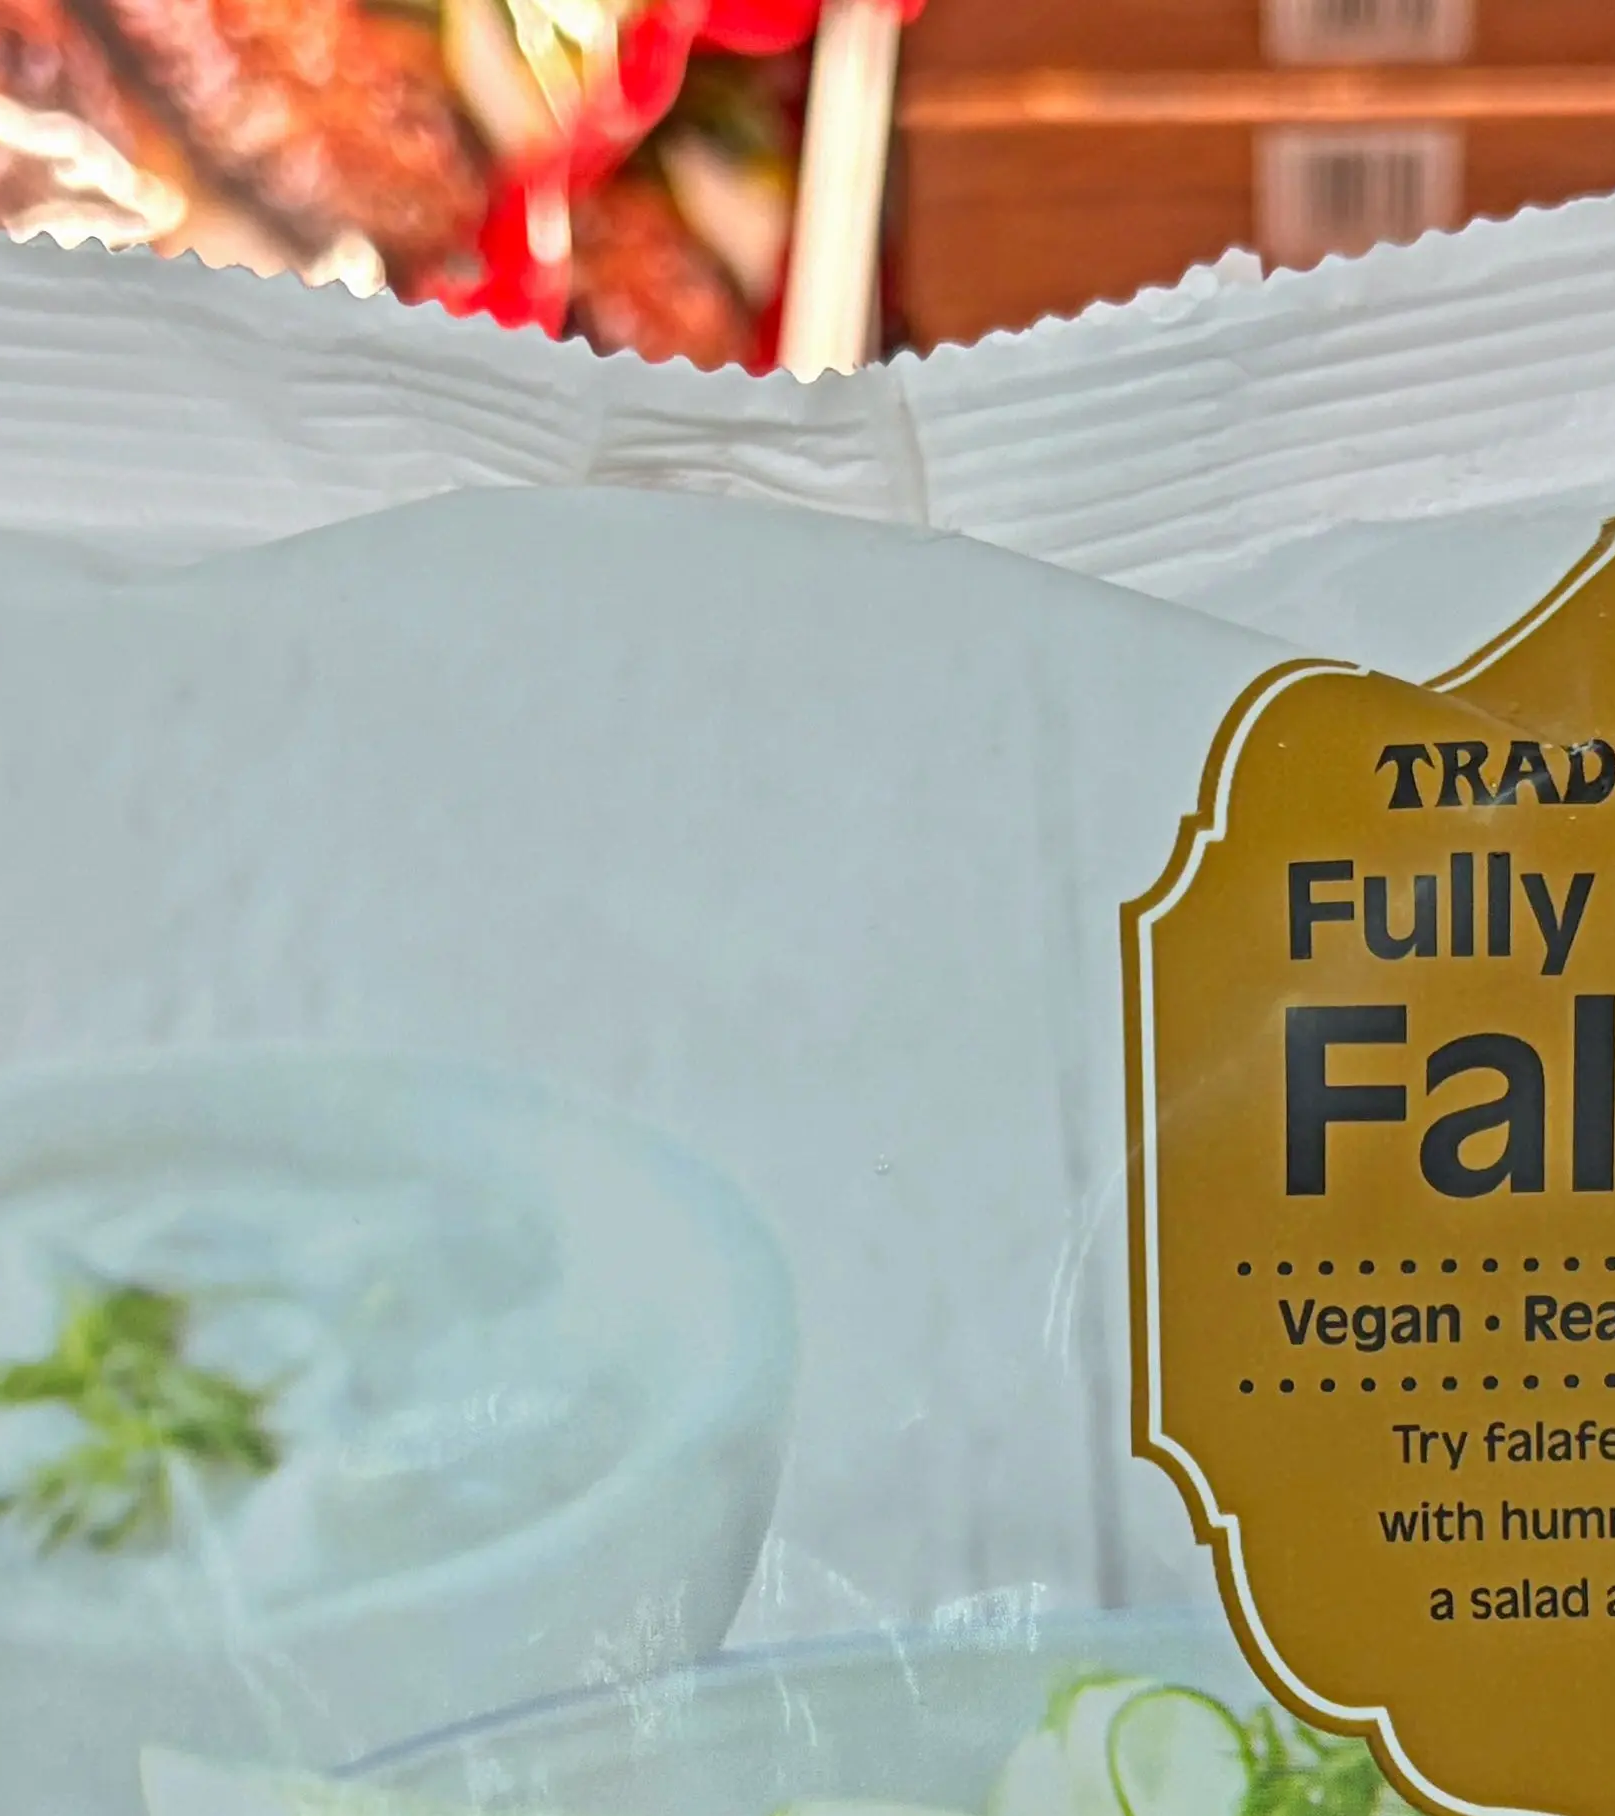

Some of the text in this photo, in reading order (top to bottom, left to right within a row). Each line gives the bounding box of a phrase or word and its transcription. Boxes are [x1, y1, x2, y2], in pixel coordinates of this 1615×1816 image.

[1288, 851, 1596, 976] Fully
[1278, 1298, 1461, 1353] Vegan
[1391, 1424, 1468, 1471] Try
[1378, 1501, 1484, 1543] with
[1430, 1587, 1454, 1621] a
[1470, 1577, 1590, 1620] salad
